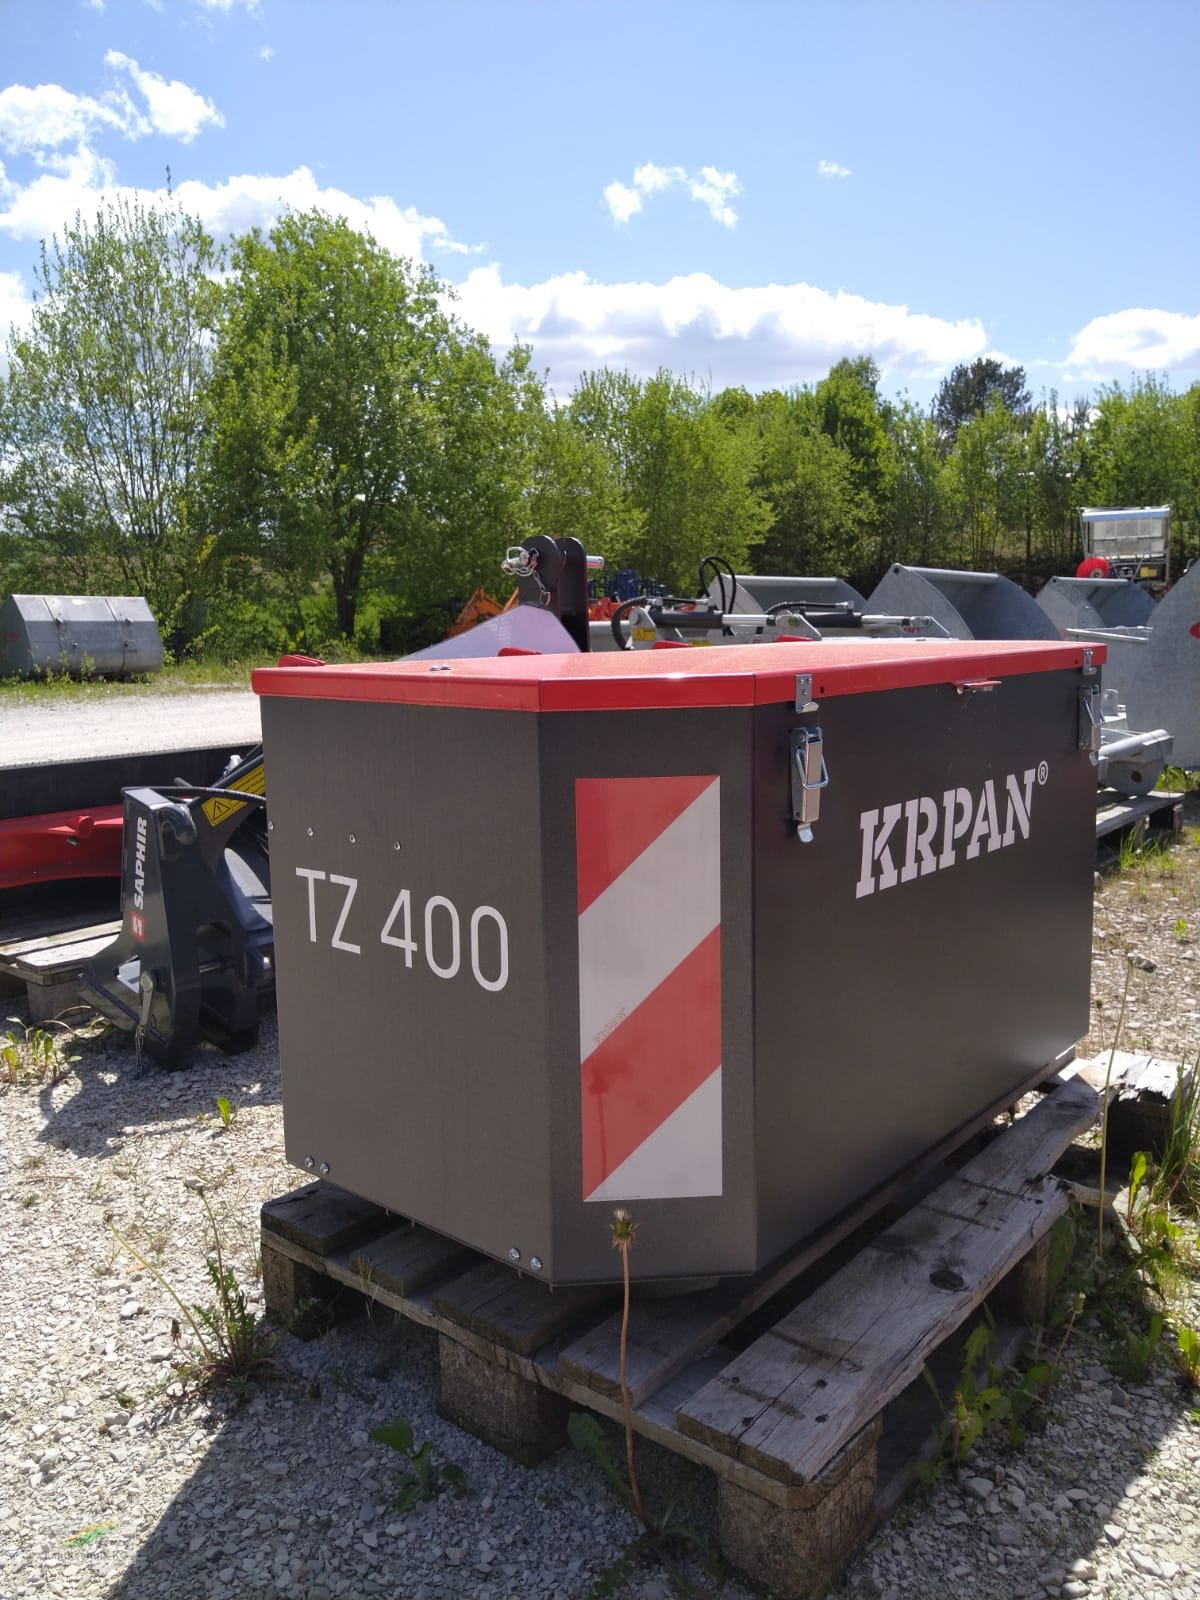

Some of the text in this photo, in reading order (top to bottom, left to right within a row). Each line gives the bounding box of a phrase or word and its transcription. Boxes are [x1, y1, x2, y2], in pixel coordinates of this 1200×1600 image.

[134, 816, 147, 911] SAPHIR
[295, 867, 509, 992] TZ 400
